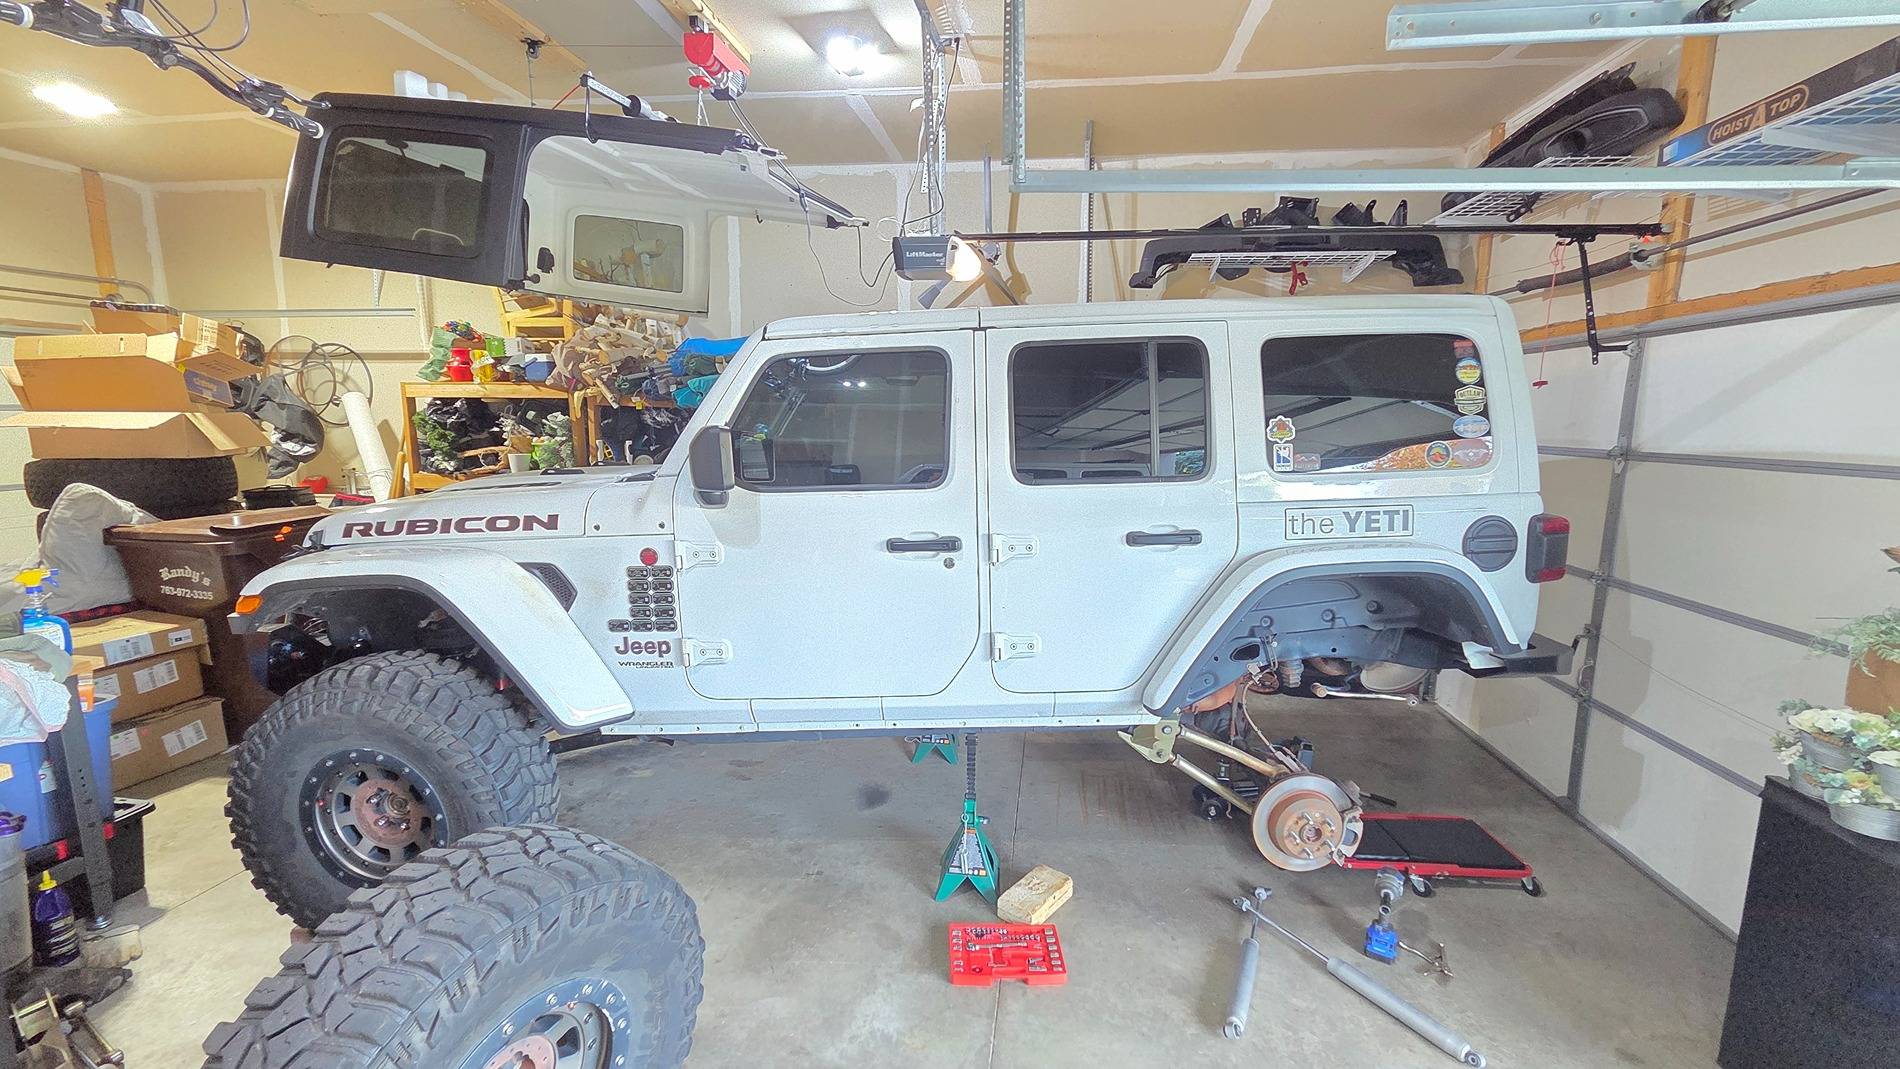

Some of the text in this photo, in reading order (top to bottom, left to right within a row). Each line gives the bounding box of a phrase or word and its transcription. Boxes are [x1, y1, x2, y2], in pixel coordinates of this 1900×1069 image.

[1712, 93, 1802, 140] HOIST A TOP
[342, 513, 560, 538] RUBICON
[1288, 509, 1410, 534] the YETI
[159, 566, 211, 586] Randy's
[160, 585, 213, 600] 763-972-3335
[615, 636, 671, 658] Jeep
